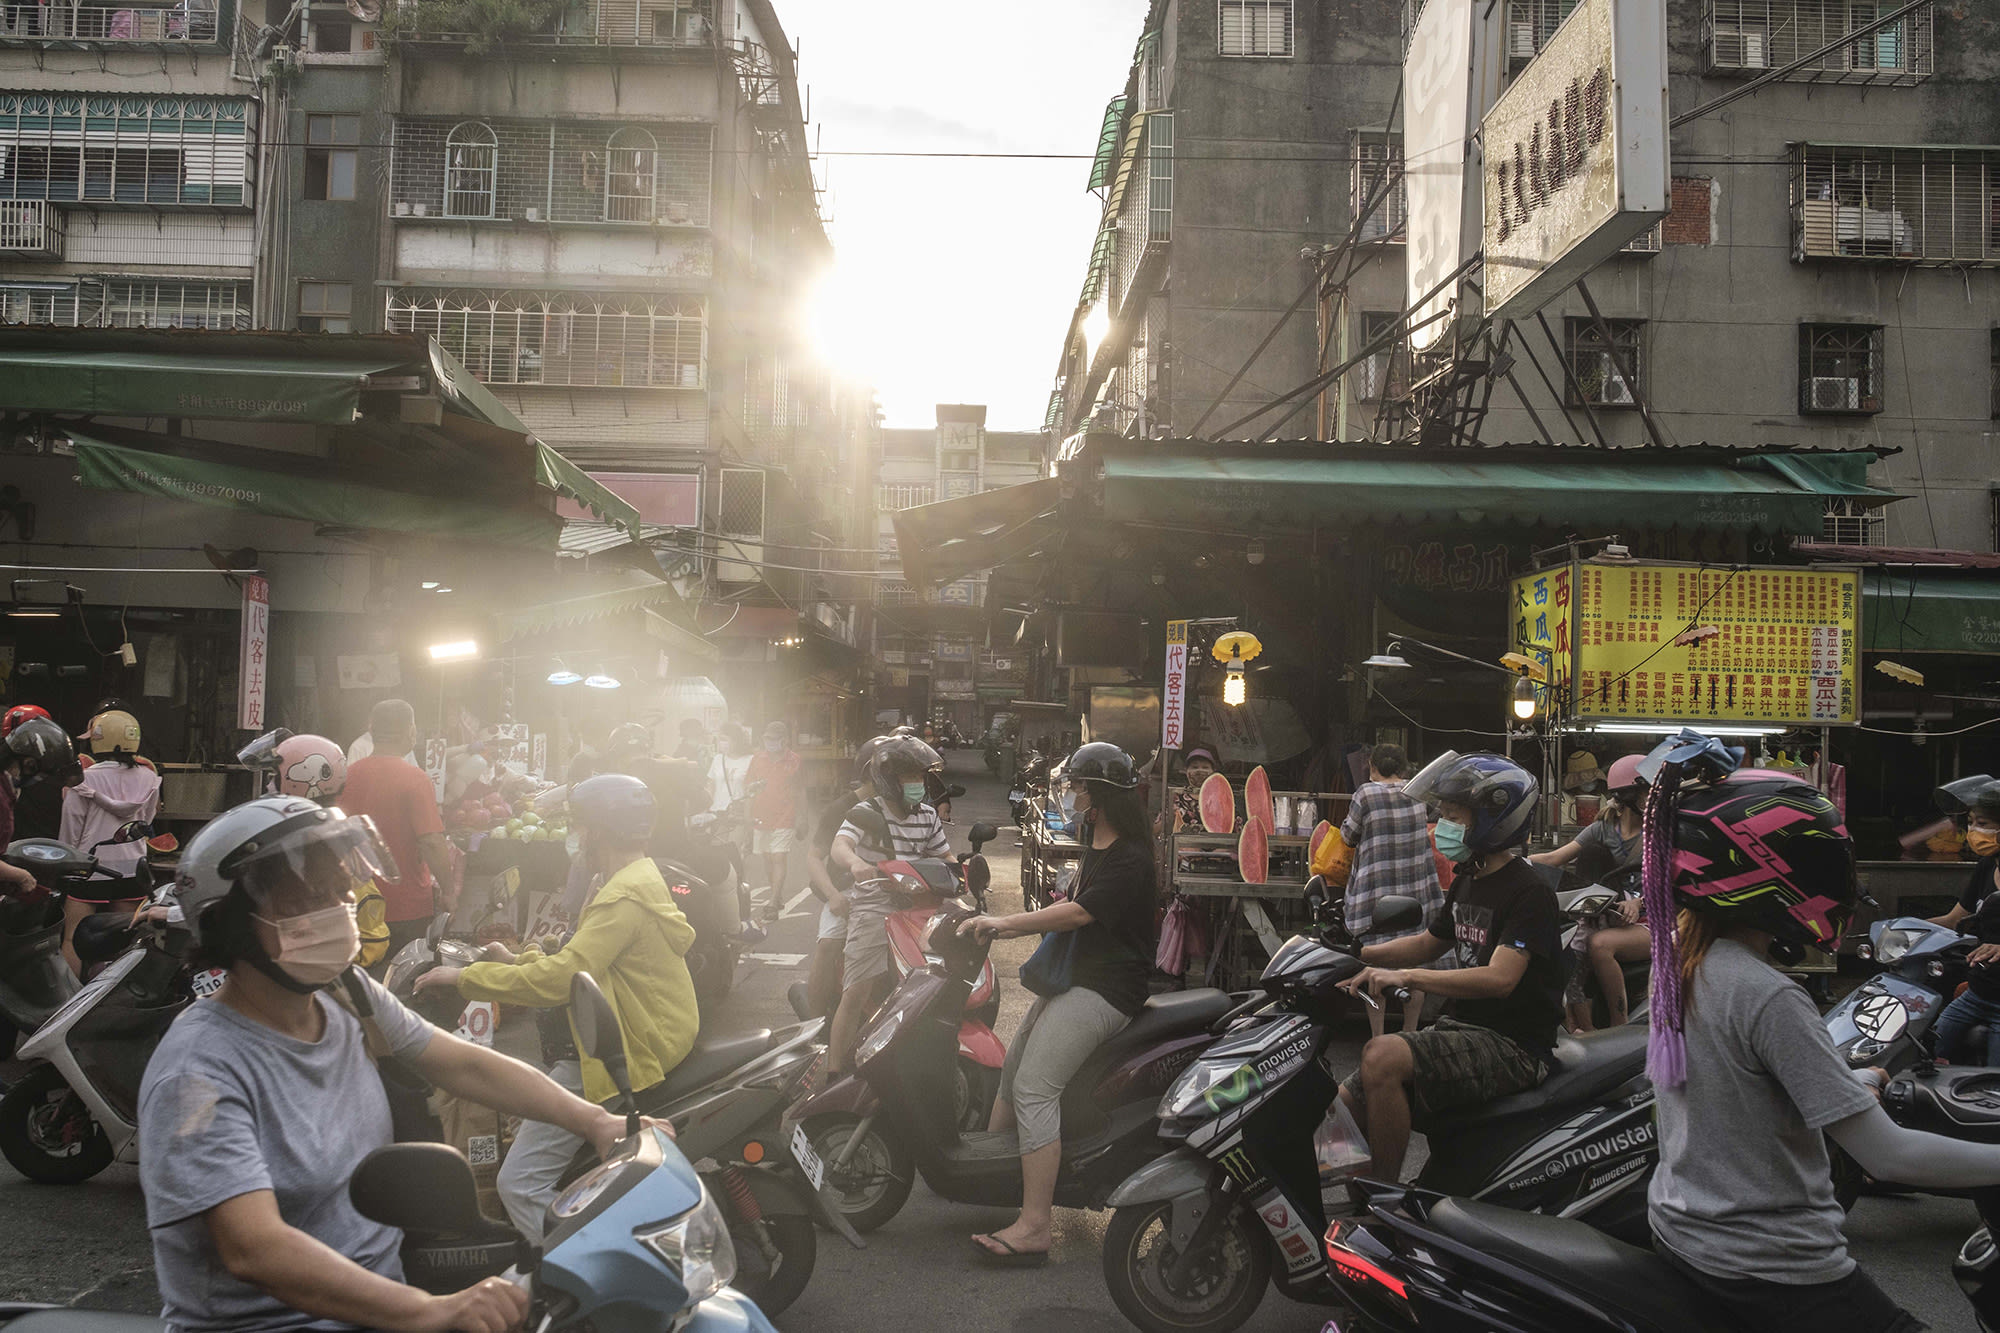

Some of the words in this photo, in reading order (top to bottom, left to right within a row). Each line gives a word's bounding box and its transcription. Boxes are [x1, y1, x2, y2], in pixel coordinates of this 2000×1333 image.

[249, 605, 266, 727] 代客去皮
[1812, 627, 1822, 669] 木瓜牛奶
[1166, 646, 1183, 747] 代客去皮
[1672, 673, 1684, 708] 芒果汁
[1795, 676, 1808, 712] 甘蔗汁
[1816, 676, 1836, 712] 西瓜汁
[1278, 1023, 1312, 1044] IVECO
[1257, 1035, 1311, 1074] movistar
[1562, 1121, 1654, 1168] movistar
[1508, 1174, 1546, 1191] ENEOS
[1589, 1153, 1648, 1191] BRIDGESTONE
[427, 1249, 489, 1267] YAMAHA
